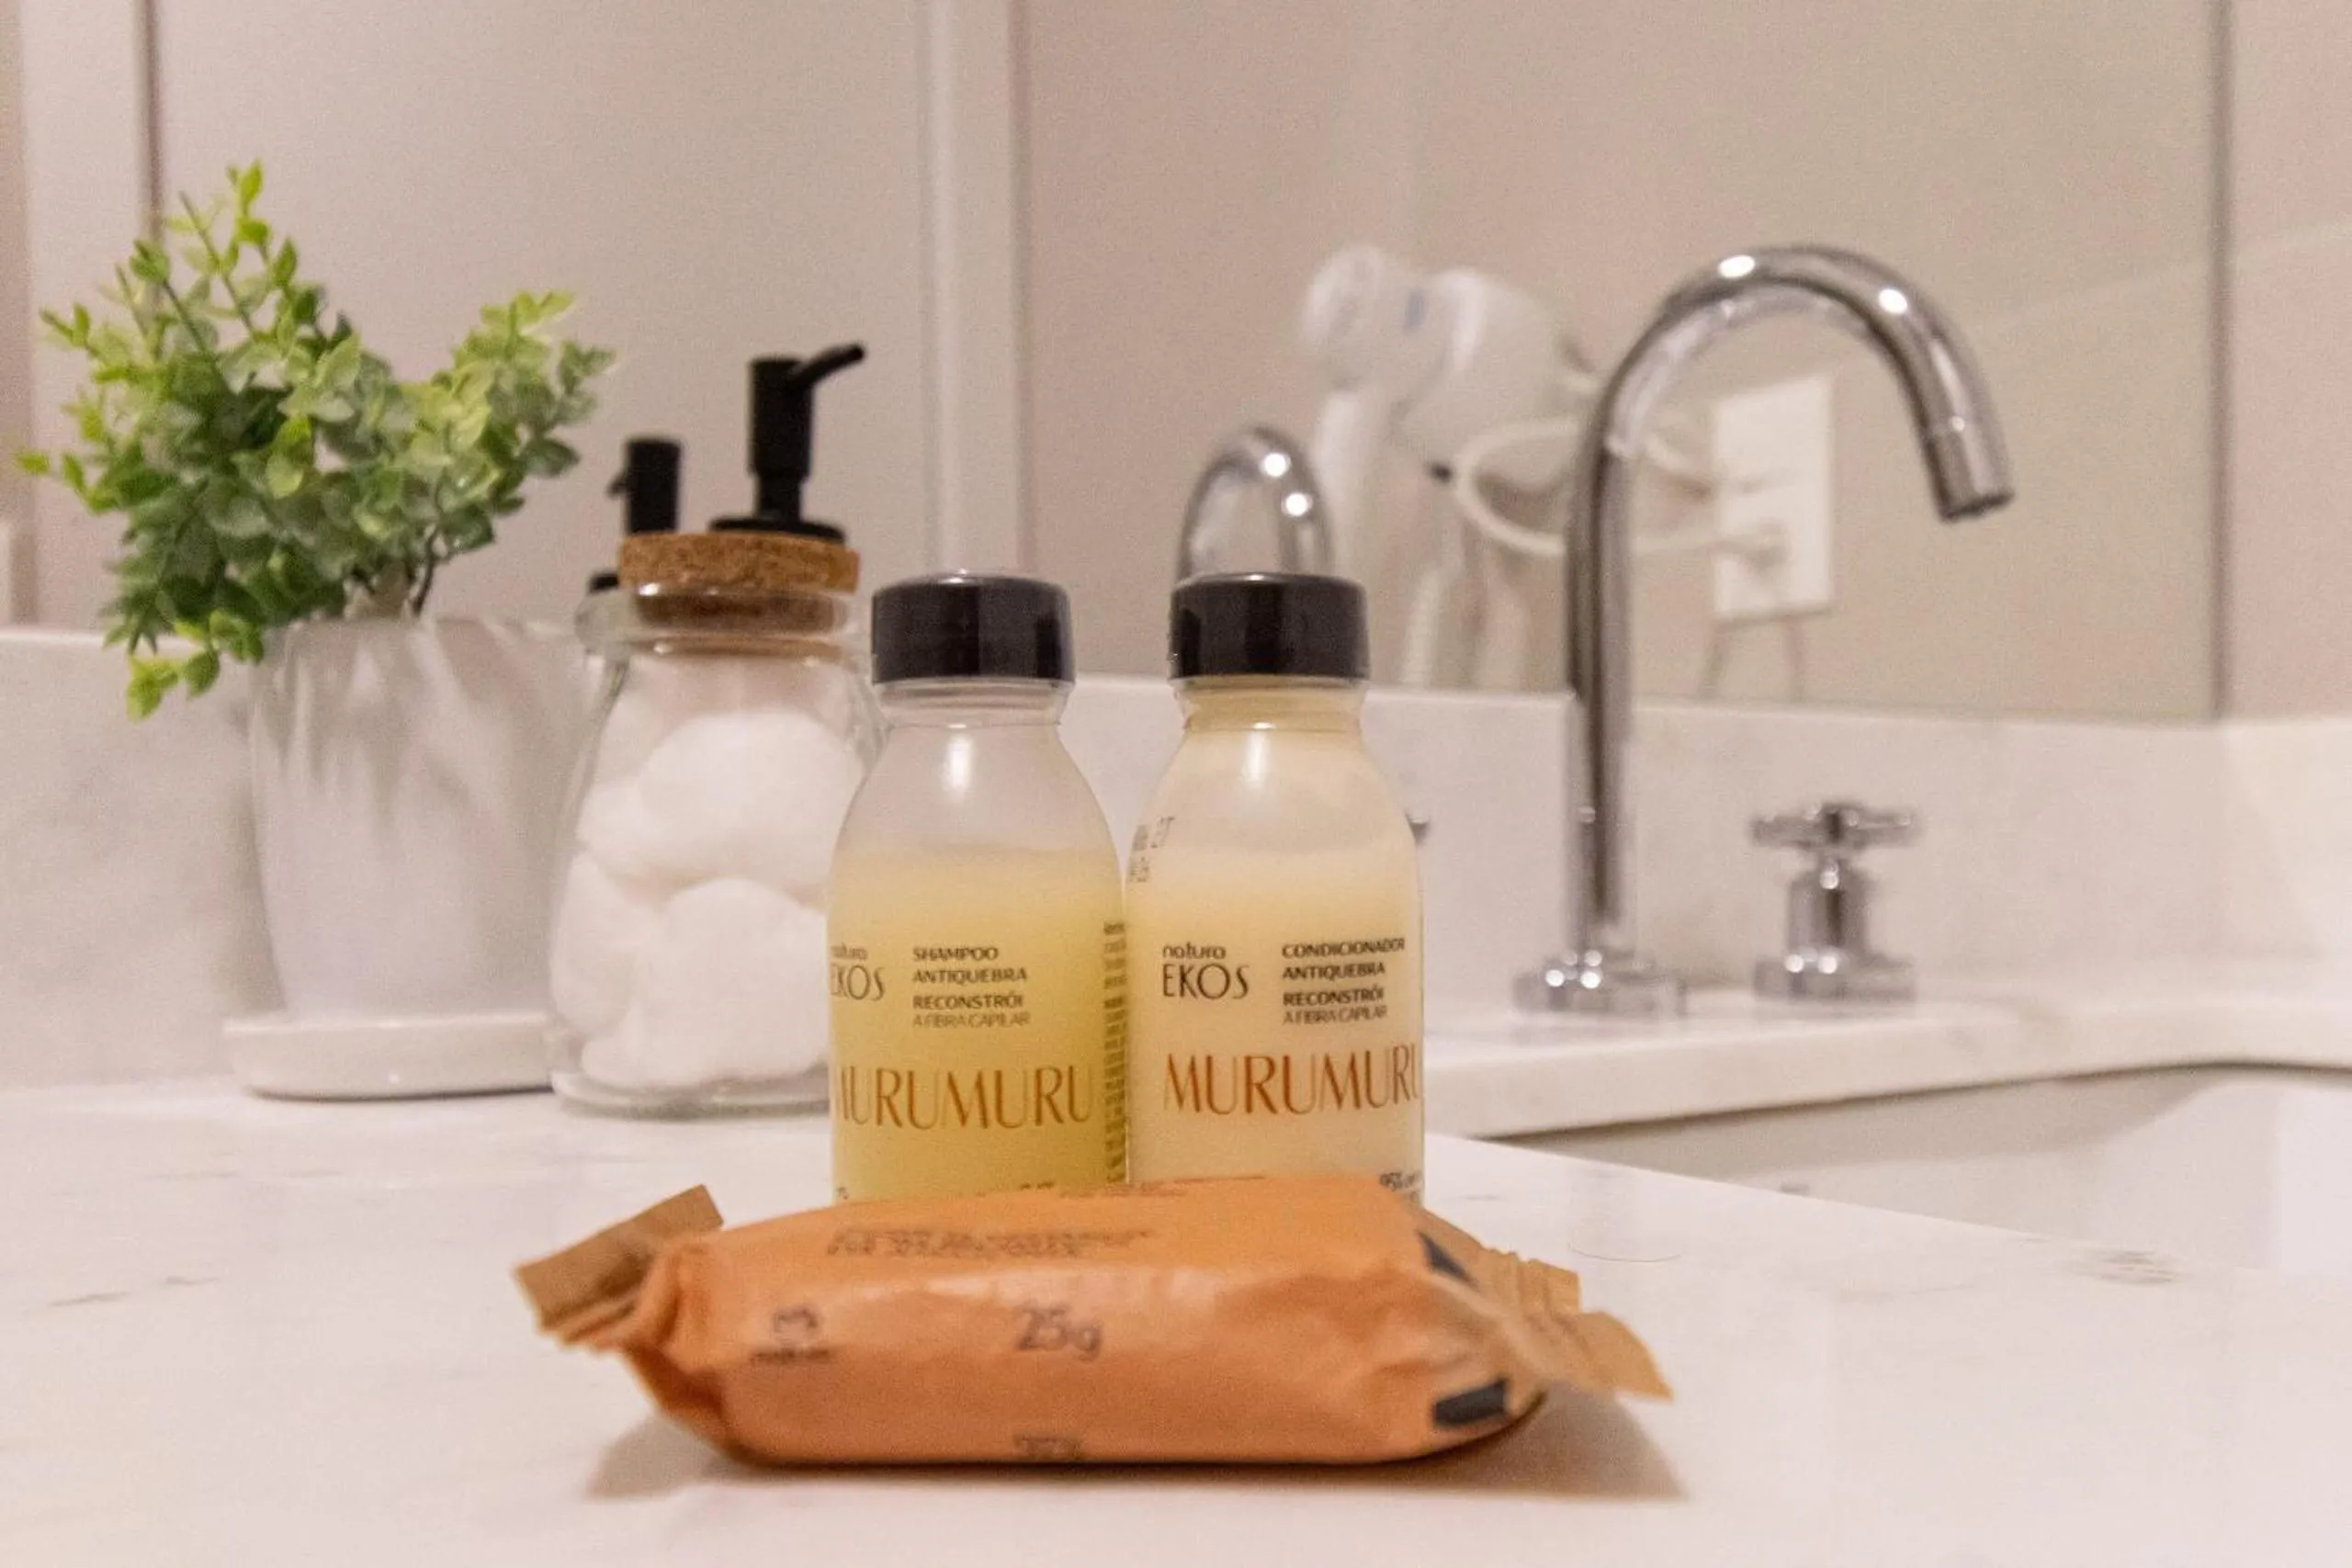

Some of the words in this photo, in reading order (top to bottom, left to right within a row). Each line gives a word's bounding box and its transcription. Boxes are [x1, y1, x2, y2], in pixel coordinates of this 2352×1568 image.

[912, 947, 999, 962] SHAMPOO
[1162, 941, 1227, 959] natura
[1282, 937, 1405, 958] CONDICIONADOR
[911, 967, 1027, 985] ANTIQUEBRA
[1162, 963, 1250, 1000] EKOS
[1283, 963, 1385, 981] ANTIQUEBRA
[912, 990, 1023, 1010] RECONSTRÓI
[1283, 984, 1385, 1006] RECONSTRÓI
[1015, 1303, 1102, 1362] 25g
